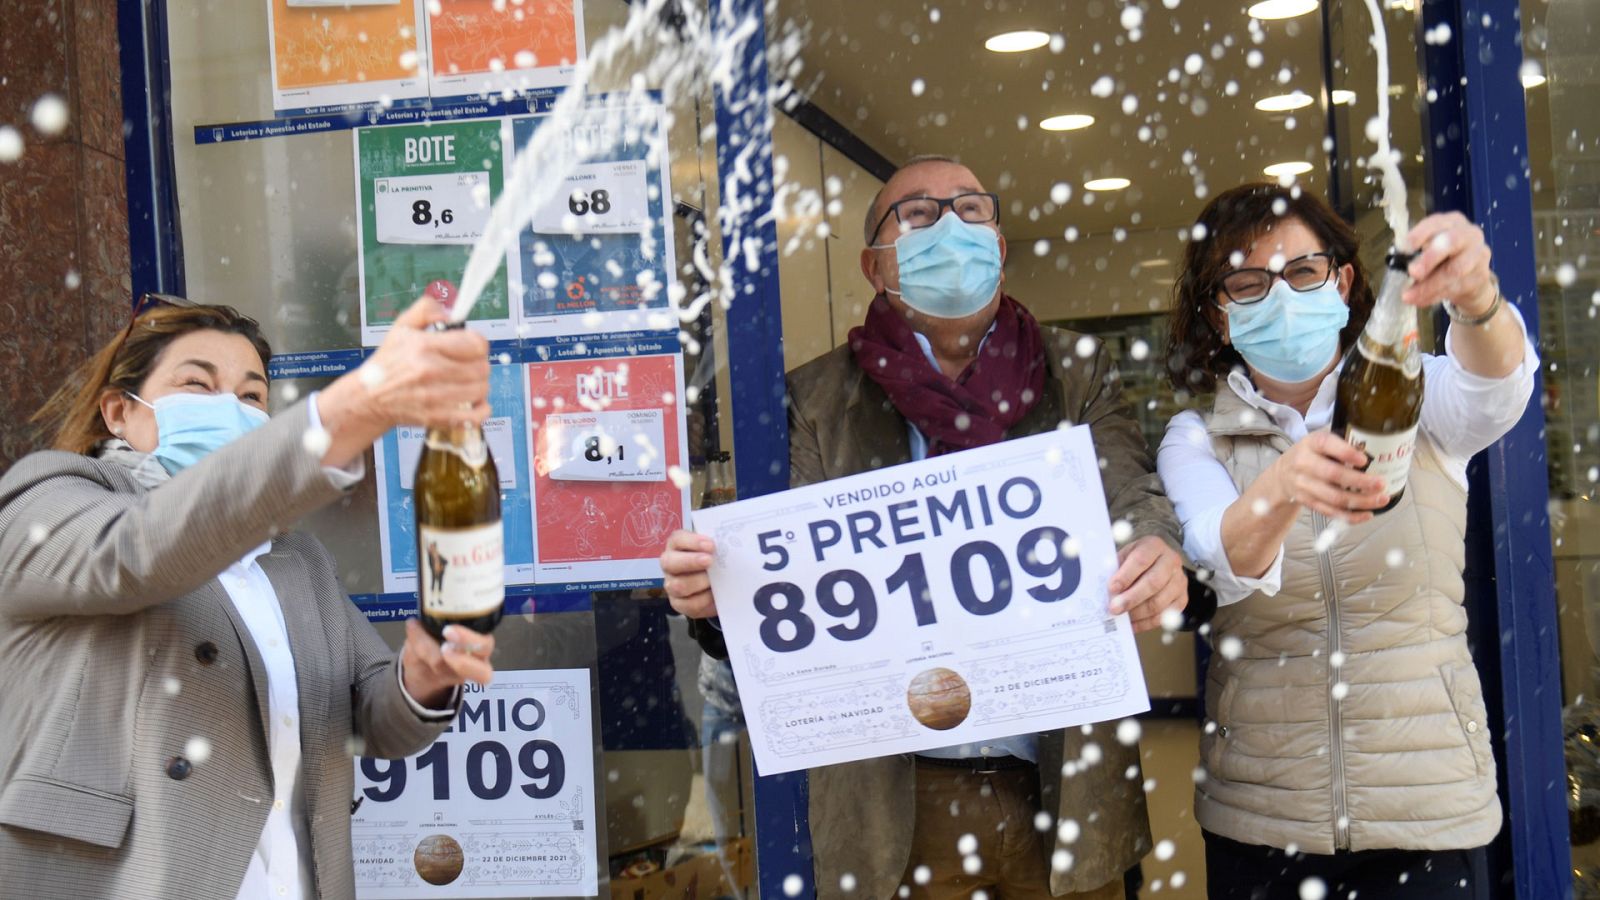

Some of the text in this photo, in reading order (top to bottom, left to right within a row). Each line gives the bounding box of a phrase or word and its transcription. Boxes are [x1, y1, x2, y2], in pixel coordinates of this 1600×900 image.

[421, 108, 452, 119] Apuestas
[453, 107, 464, 116] del
[465, 105, 488, 116] Estado
[265, 125, 296, 135] Apuestas
[297, 123, 307, 131] del
[308, 121, 331, 131] Estado
[404, 135, 456, 163] BOTE
[412, 199, 454, 228] 8,6
[568, 189, 611, 216] 68
[593, 345, 625, 356] Apuestas
[638, 343, 662, 352] Estado
[279, 366, 310, 376] Apuestas
[310, 364, 322, 373] del
[323, 362, 346, 372] Estado
[576, 370, 629, 400] BOTE
[824, 467, 958, 509] VENDIDO AQUÍ
[808, 476, 1042, 562] PREMIO
[565, 583, 580, 592] Que
[588, 582, 610, 590] suerte
[753, 525, 1082, 653] 89109
[994, 668, 1103, 693] 22 DE DICIEMBRE 2021
[785, 715, 825, 728] LOTERÍA
[840, 706, 884, 719] NAVIDAD
[505, 855, 548, 863] DICIEMBRE
